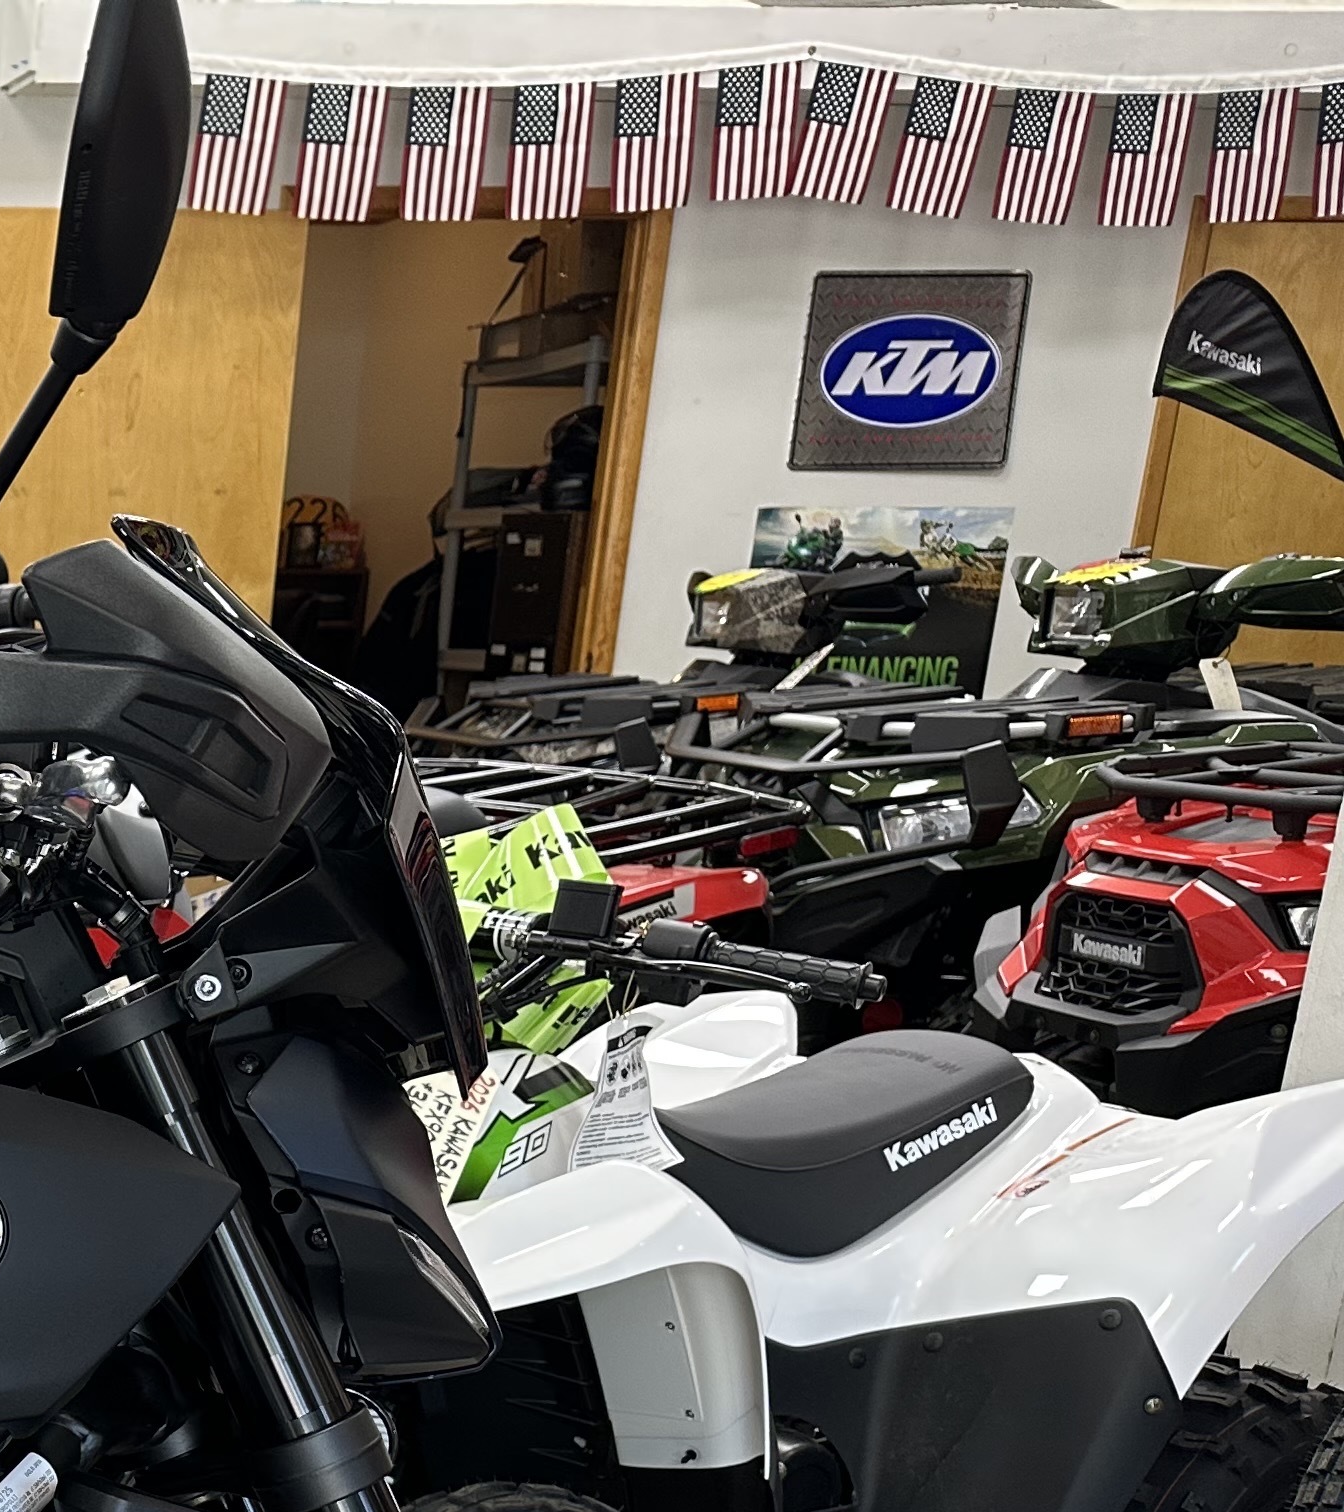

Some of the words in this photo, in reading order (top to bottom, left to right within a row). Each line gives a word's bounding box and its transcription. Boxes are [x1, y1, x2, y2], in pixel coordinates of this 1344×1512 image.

[830, 339, 991, 396] KTM
[1186, 330, 1262, 377] Kawasaki
[828, 655, 959, 687] FINANCING
[625, 901, 678, 930] wasaki
[1073, 932, 1142, 966] Kawasaki
[498, 1121, 553, 1179] 90
[883, 1096, 998, 1172] Kawasaki
